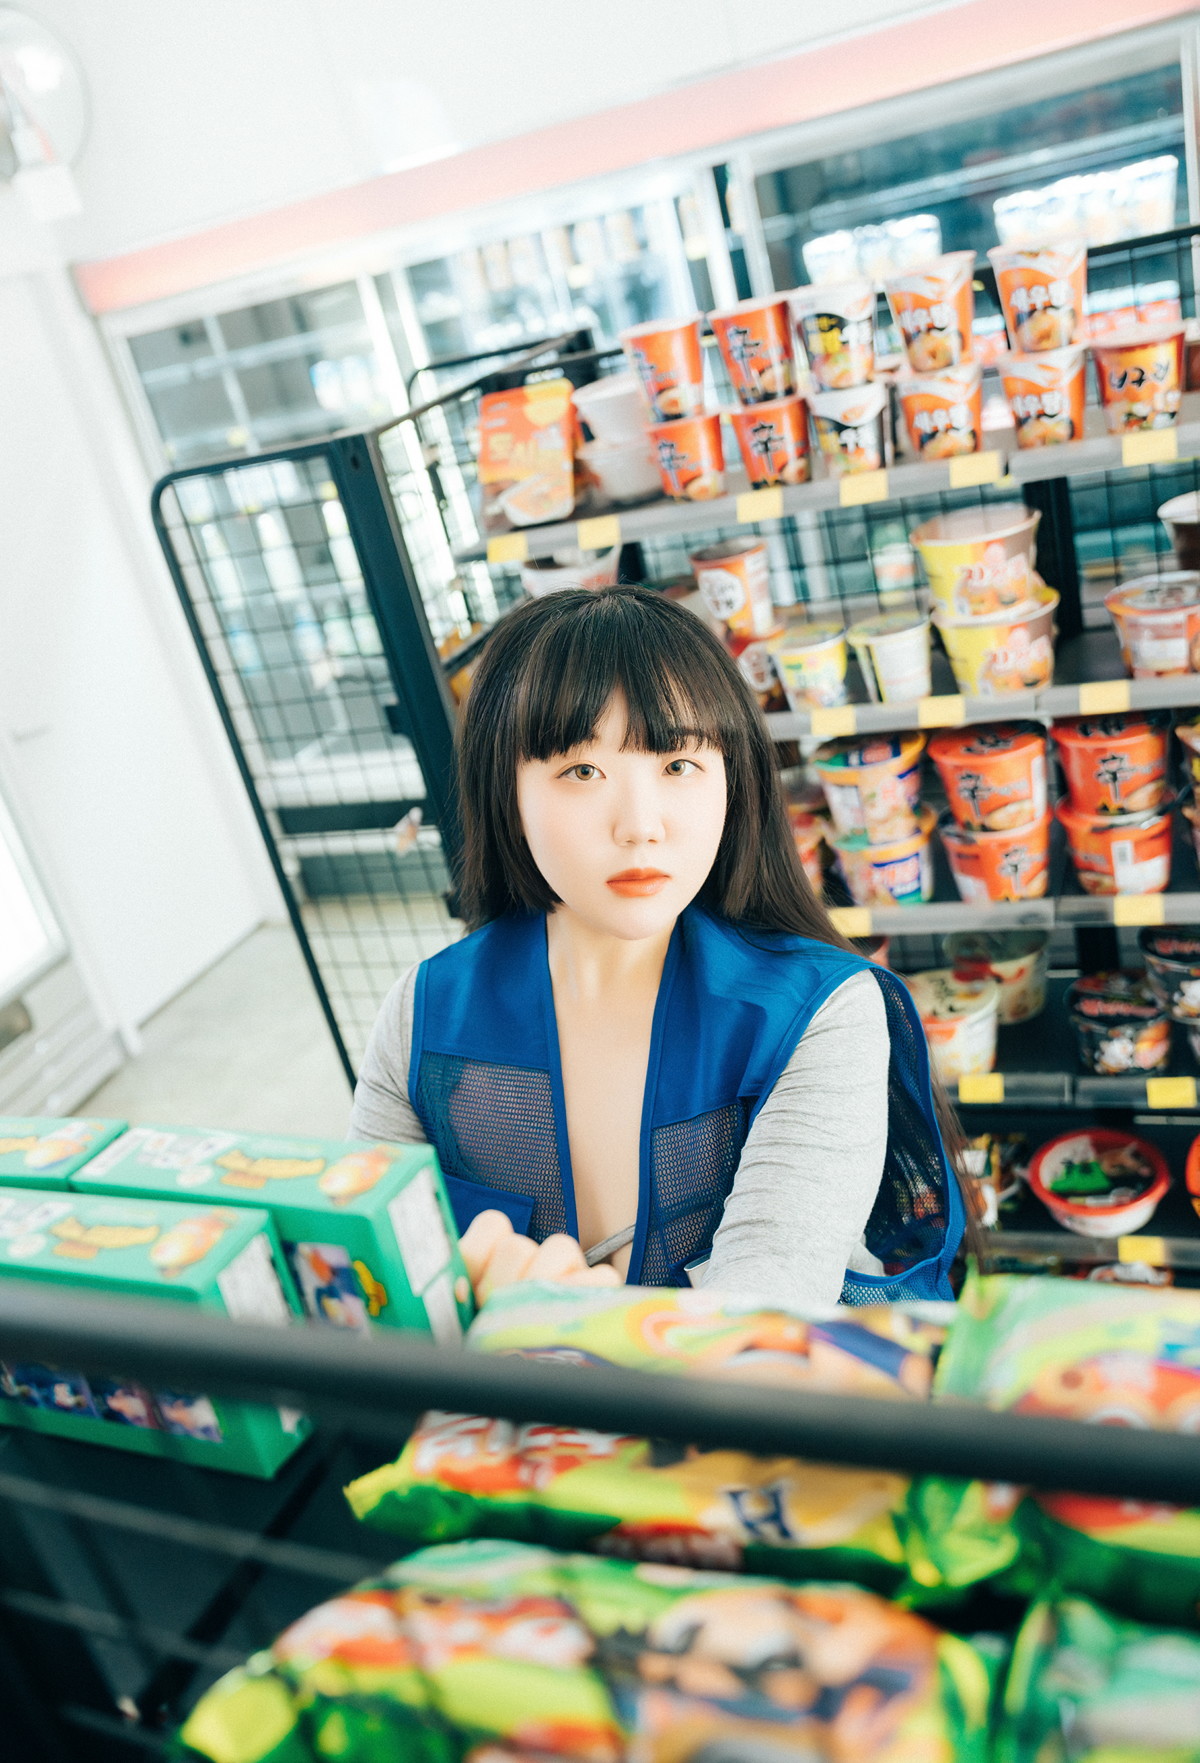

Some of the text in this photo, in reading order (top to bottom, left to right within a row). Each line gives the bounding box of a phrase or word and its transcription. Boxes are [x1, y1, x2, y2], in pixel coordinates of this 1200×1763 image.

[752, 421, 784, 475] 辛
[957, 770, 993, 818] 辛
[1096, 753, 1135, 801] 辛
